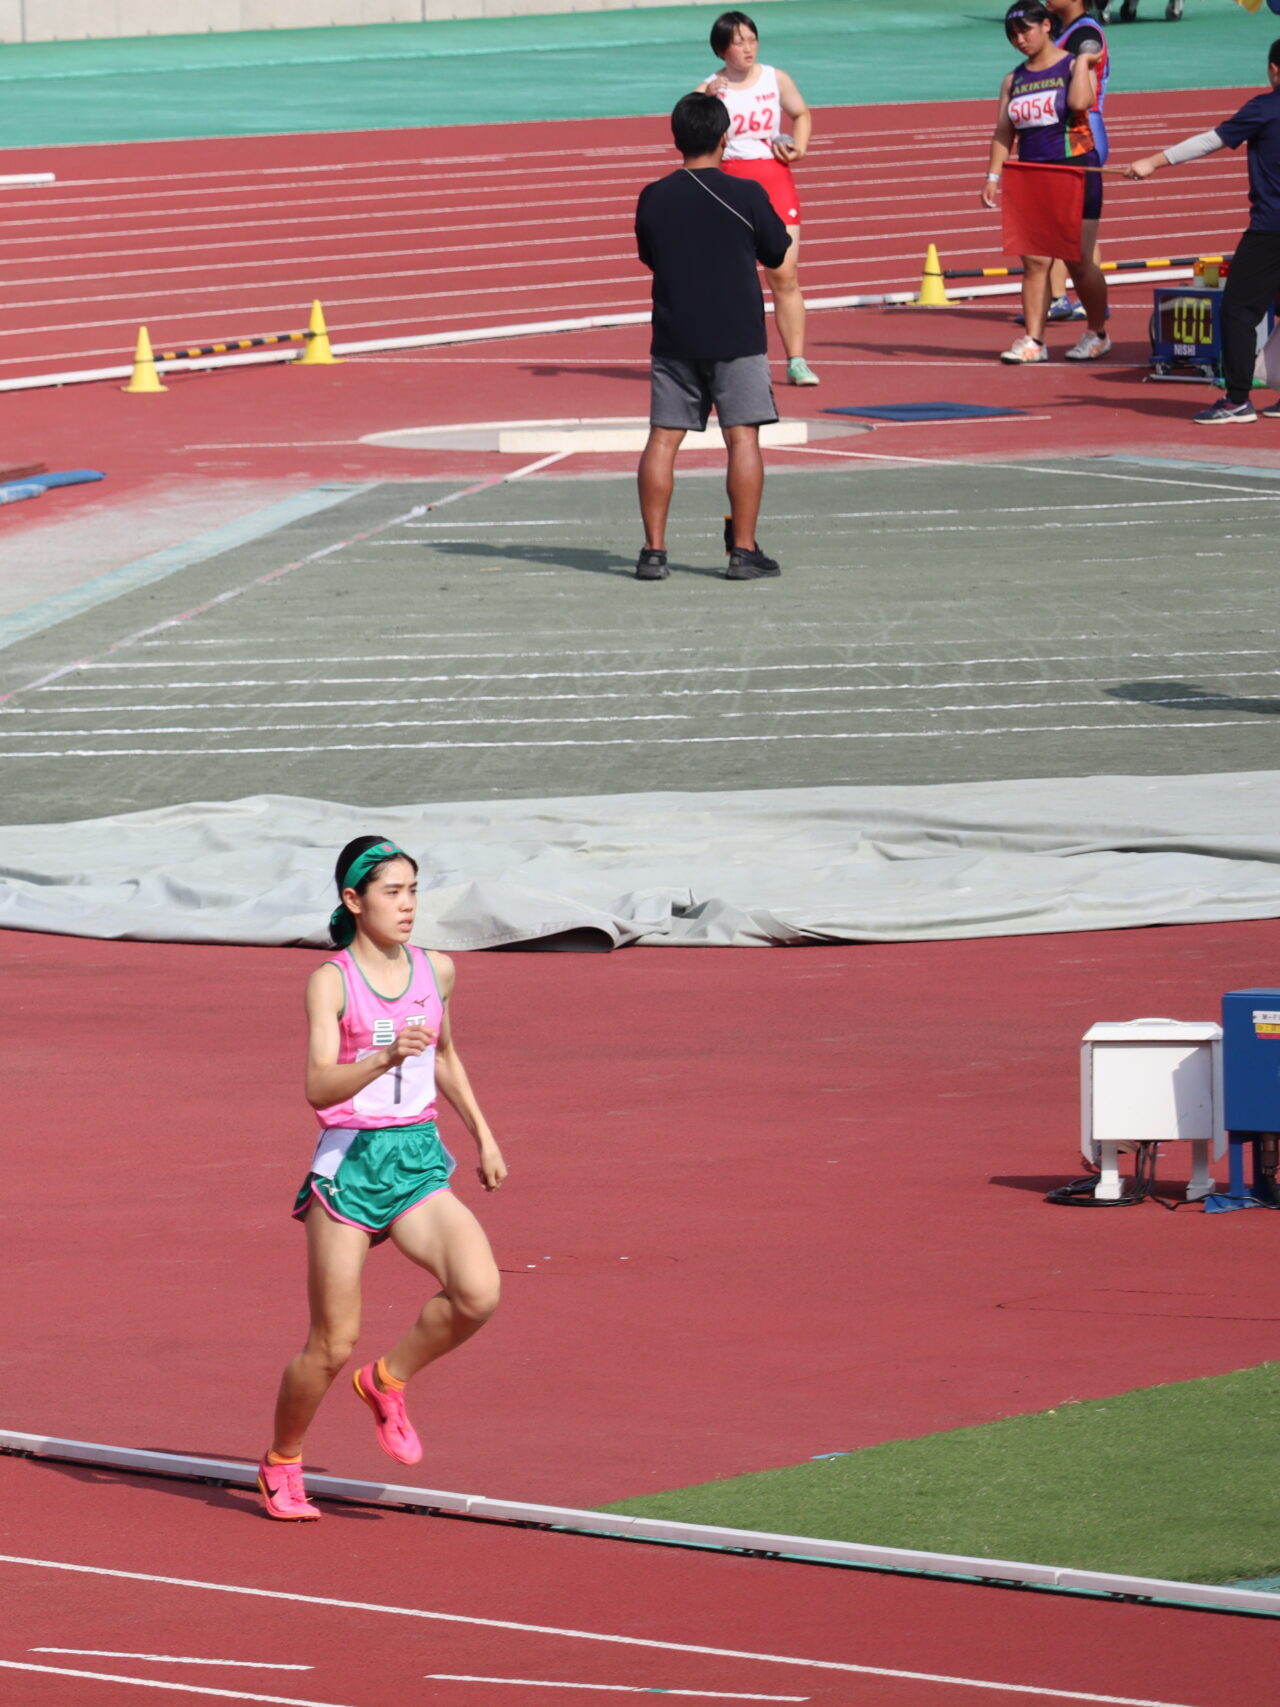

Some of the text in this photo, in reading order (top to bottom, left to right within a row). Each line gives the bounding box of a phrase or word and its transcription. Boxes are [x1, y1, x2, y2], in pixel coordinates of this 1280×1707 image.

[1013, 78, 1064, 95] AKIKUSA
[1010, 97, 1054, 123] 5054
[733, 108, 773, 136] 262
[1174, 344, 1196, 356] NISHI
